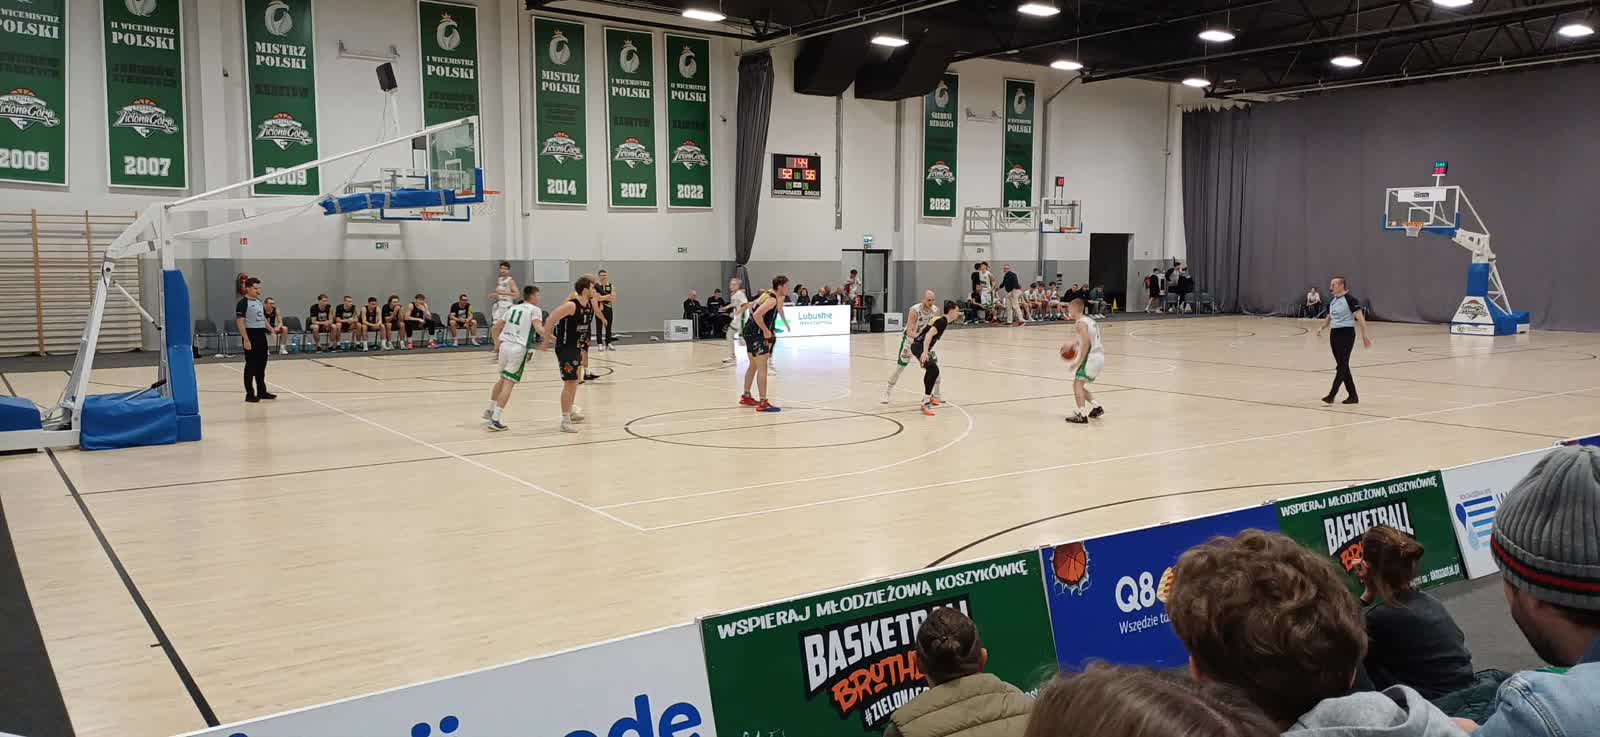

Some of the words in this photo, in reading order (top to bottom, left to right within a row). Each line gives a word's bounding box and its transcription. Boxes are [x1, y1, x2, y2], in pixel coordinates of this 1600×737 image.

[0, 20, 59, 39] OLSKI
[121, 23, 175, 35] WICEMISTRZ
[112, 31, 175, 50] POLSKI
[255, 41, 307, 56] MISTRZ
[255, 55, 307, 69] POLSKI
[427, 64, 474, 80] POLSKI
[542, 70, 580, 83] MISTRZ
[541, 81, 580, 95] POLSKI
[611, 86, 651, 99] POLSKI
[671, 90, 707, 102] POLSKI
[1007, 124, 1032, 134] POLSKI
[0, 149, 50, 171] 2006
[124, 155, 171, 177] 2007
[547, 178, 577, 196] 2014
[620, 183, 648, 199] 2017
[677, 184, 704, 199] 2022
[929, 198, 951, 211] 2023
[509, 309, 523, 325] 11
[1280, 499, 1327, 517] WSPIERAJ
[717, 606, 811, 640] WSPIERAJ
[816, 581, 933, 618] MŁODZIEŻOWĄ
[935, 559, 1029, 592] KOSZYKÓWKĘ
[1115, 571, 1156, 613] Q8
[1119, 614, 1159, 635] Wszędzie
